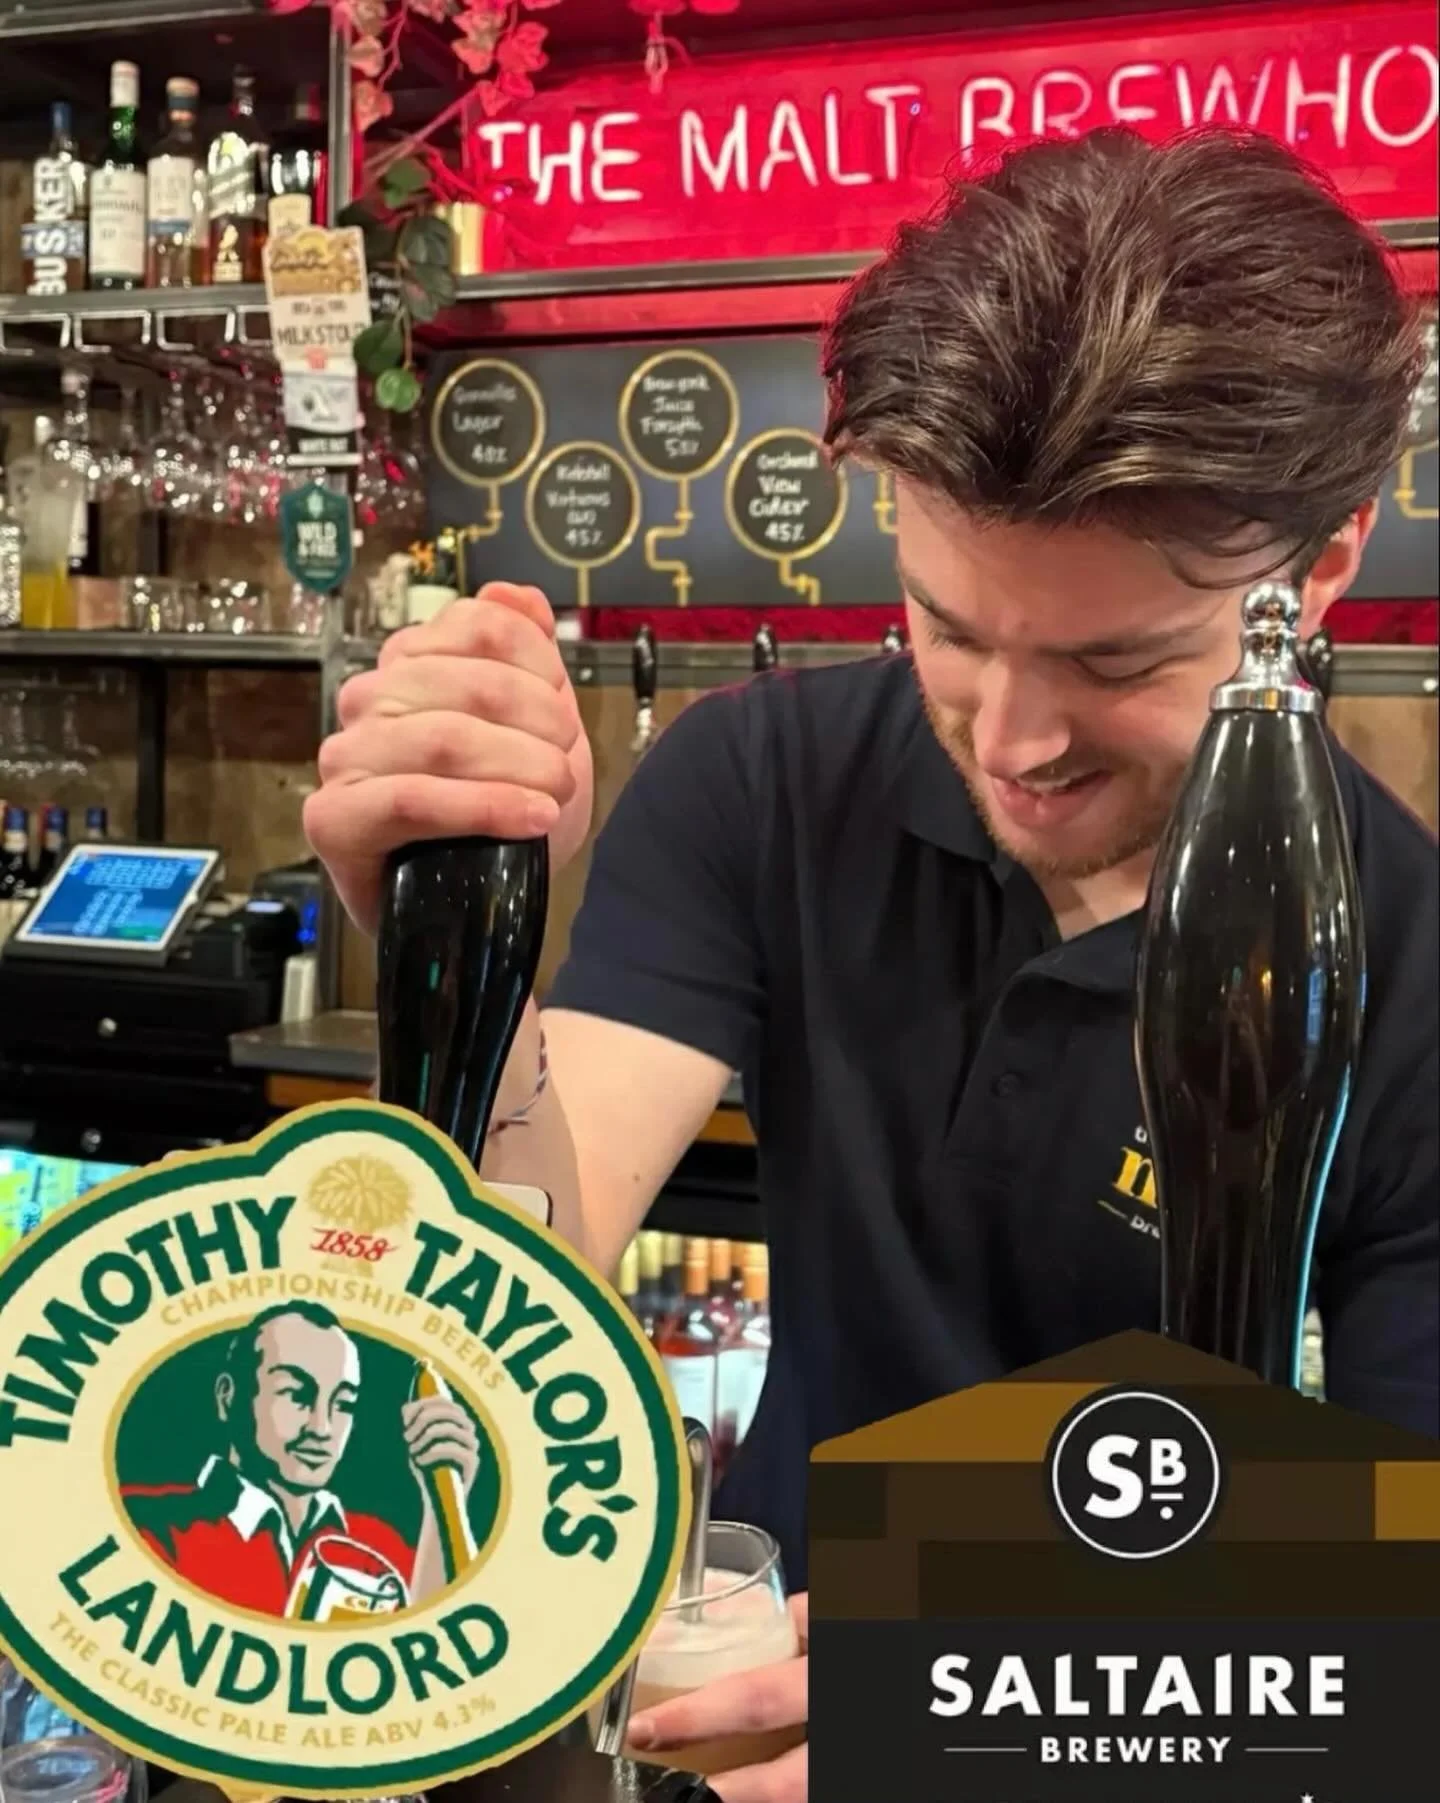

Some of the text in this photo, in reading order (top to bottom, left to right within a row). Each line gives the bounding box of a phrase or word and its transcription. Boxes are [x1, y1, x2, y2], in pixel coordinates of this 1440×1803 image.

[478, 112, 643, 205] THE
[679, 84, 921, 198] MALT
[311, 1228, 396, 1262] 1858
[0, 1196, 638, 1563] TIMOTHY TAYLOR'S
[160, 1273, 506, 1391] CHAMPIONSHIP BEERS
[49, 1611, 498, 1749] THE CLASSIC PALE ALE ABV 4.3%
[58, 1535, 510, 1716] LANDLORD
[929, 1653, 1345, 1717] SALTAIRE
[1041, 1736, 1231, 1763] BREWERY
